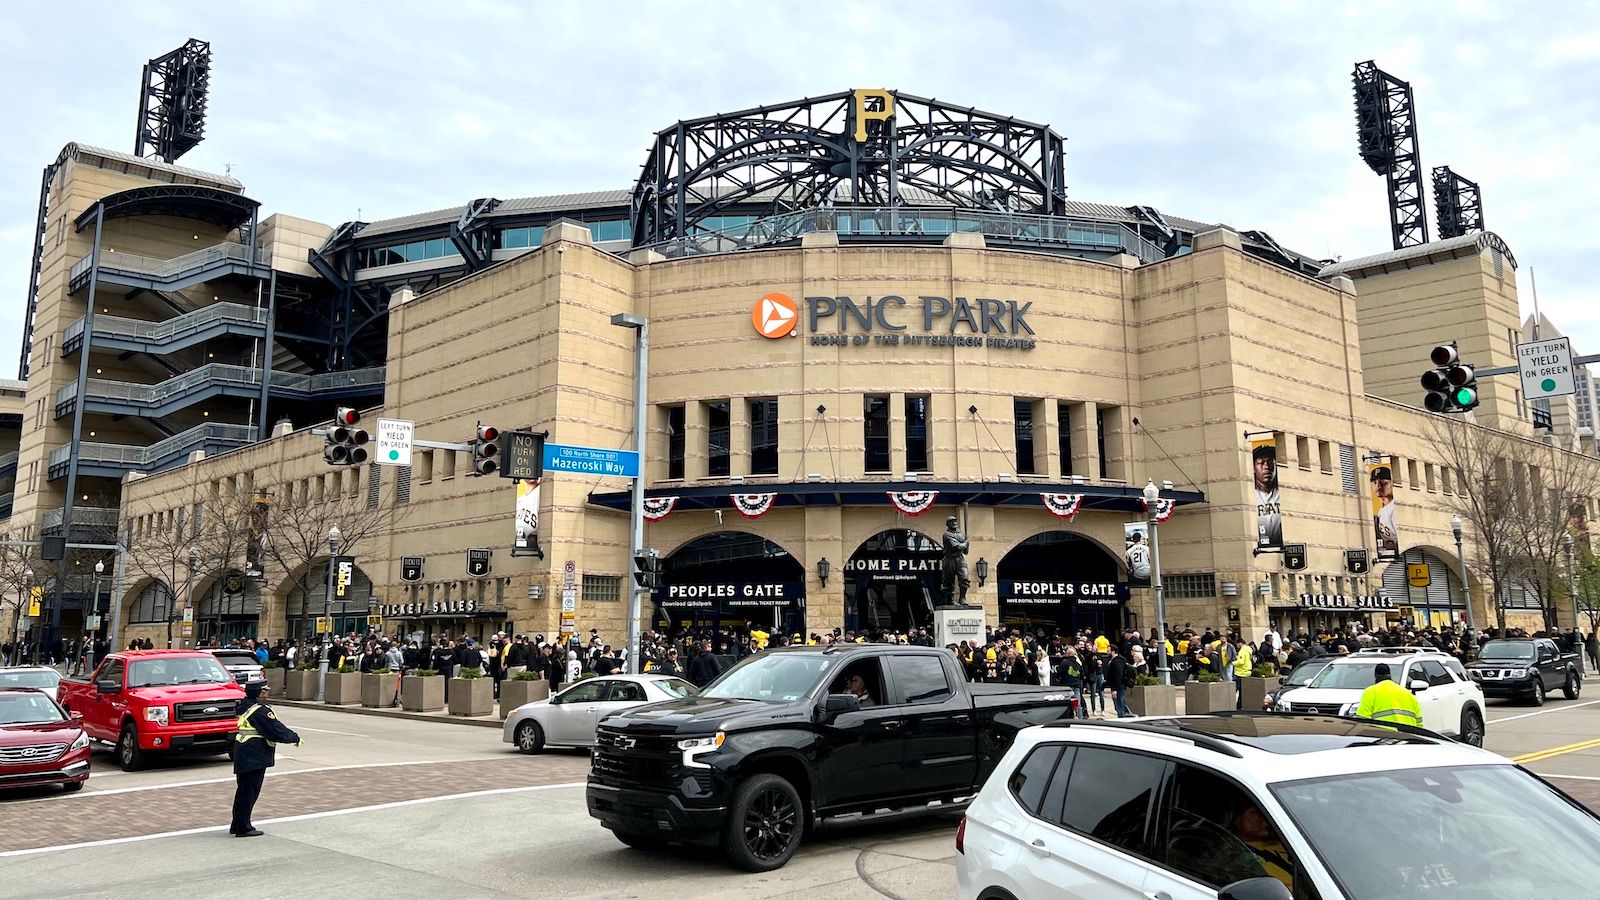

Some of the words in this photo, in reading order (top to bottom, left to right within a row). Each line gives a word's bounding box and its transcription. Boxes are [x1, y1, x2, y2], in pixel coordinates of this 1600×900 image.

[853, 88, 895, 142] P
[805, 295, 907, 332] PNC
[918, 296, 1036, 336] PARK
[811, 335, 848, 346] HOME
[852, 335, 870, 346] OF
[874, 335, 899, 346] THE
[903, 335, 983, 347] PITTSBURGH
[986, 337, 1036, 350] PIRATES
[1521, 346, 1540, 356] LEFT
[1544, 343, 1566, 352] TURN
[1531, 354, 1559, 366] YIELD
[1525, 370, 1537, 378] ON
[1540, 366, 1568, 376] GREEN
[380, 423, 394, 431] LEFT
[396, 424, 411, 432] TURN
[386, 432, 405, 440] YIELD
[515, 436, 533, 447] NO
[390, 441, 409, 449] GREEN
[512, 447, 535, 457] TURN
[517, 458, 529, 466] ON
[551, 457, 603, 471] Mazeroski
[605, 461, 625, 475] Way
[513, 467, 532, 476] RED
[1133, 552, 1142, 563] 21
[1291, 557, 1298, 566] P
[475, 563, 482, 572] P
[845, 559, 890, 571] HOME
[1355, 562, 1361, 571] P
[408, 569, 415, 578] P
[669, 585, 735, 597] PEOPLES
[743, 584, 784, 597] GATE
[1013, 582, 1074, 595] PEOPLES
[1080, 583, 1116, 596] GATE
[1302, 594, 1348, 606] TICKET
[1358, 596, 1393, 607] SALES
[379, 603, 423, 615] TICKET
[433, 600, 474, 612] SALES
[1230, 609, 1237, 619] P
[573, 666, 580, 676] 3
[1172, 662, 1185, 671] NC
